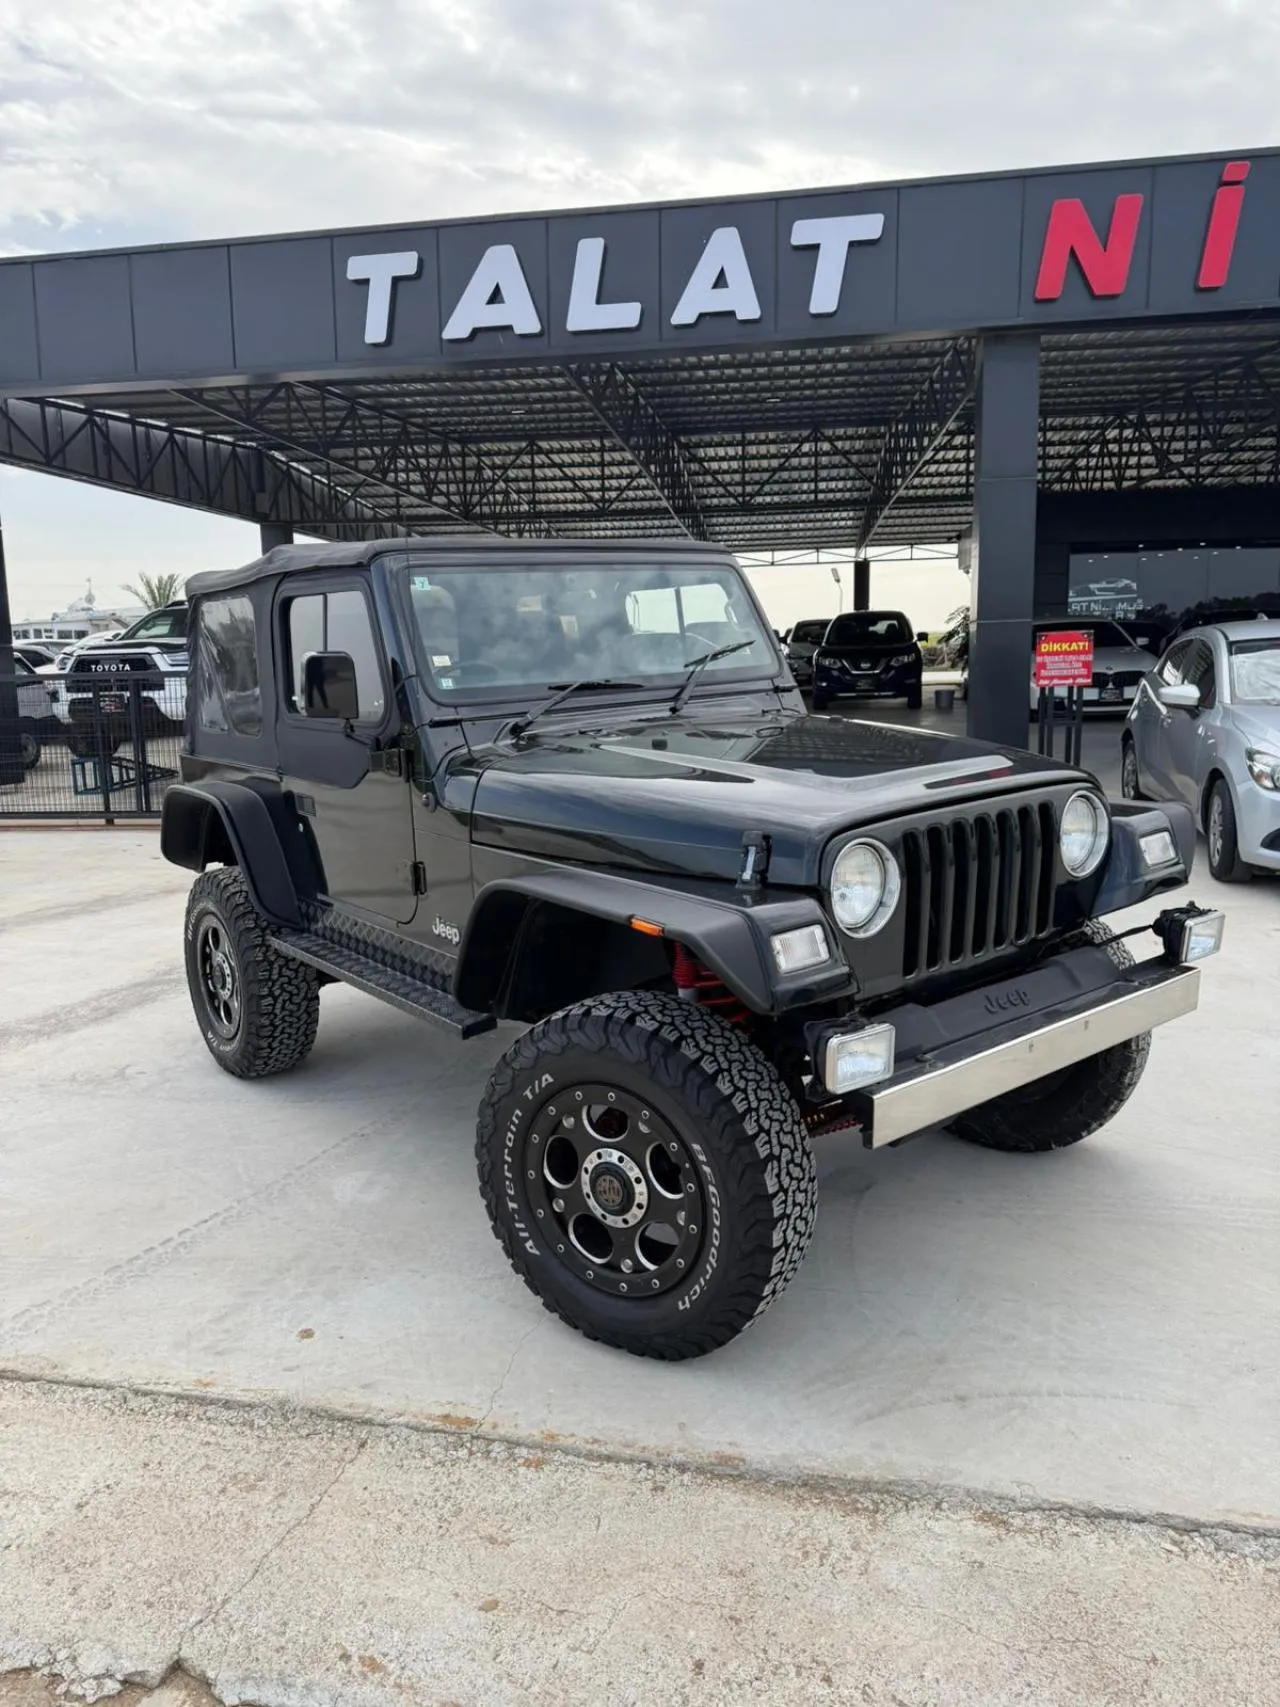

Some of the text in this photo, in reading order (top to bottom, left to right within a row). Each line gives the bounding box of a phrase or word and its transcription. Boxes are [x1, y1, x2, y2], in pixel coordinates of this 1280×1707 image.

[346, 213, 885, 345] TALAT
[91, 664, 130, 672] TOYOTA
[432, 917, 460, 945] Jeep
[984, 990, 1030, 1015] Jeep
[503, 1073, 554, 1256] All-Terrain T/A
[678, 1143, 721, 1311] BFGoodrich
